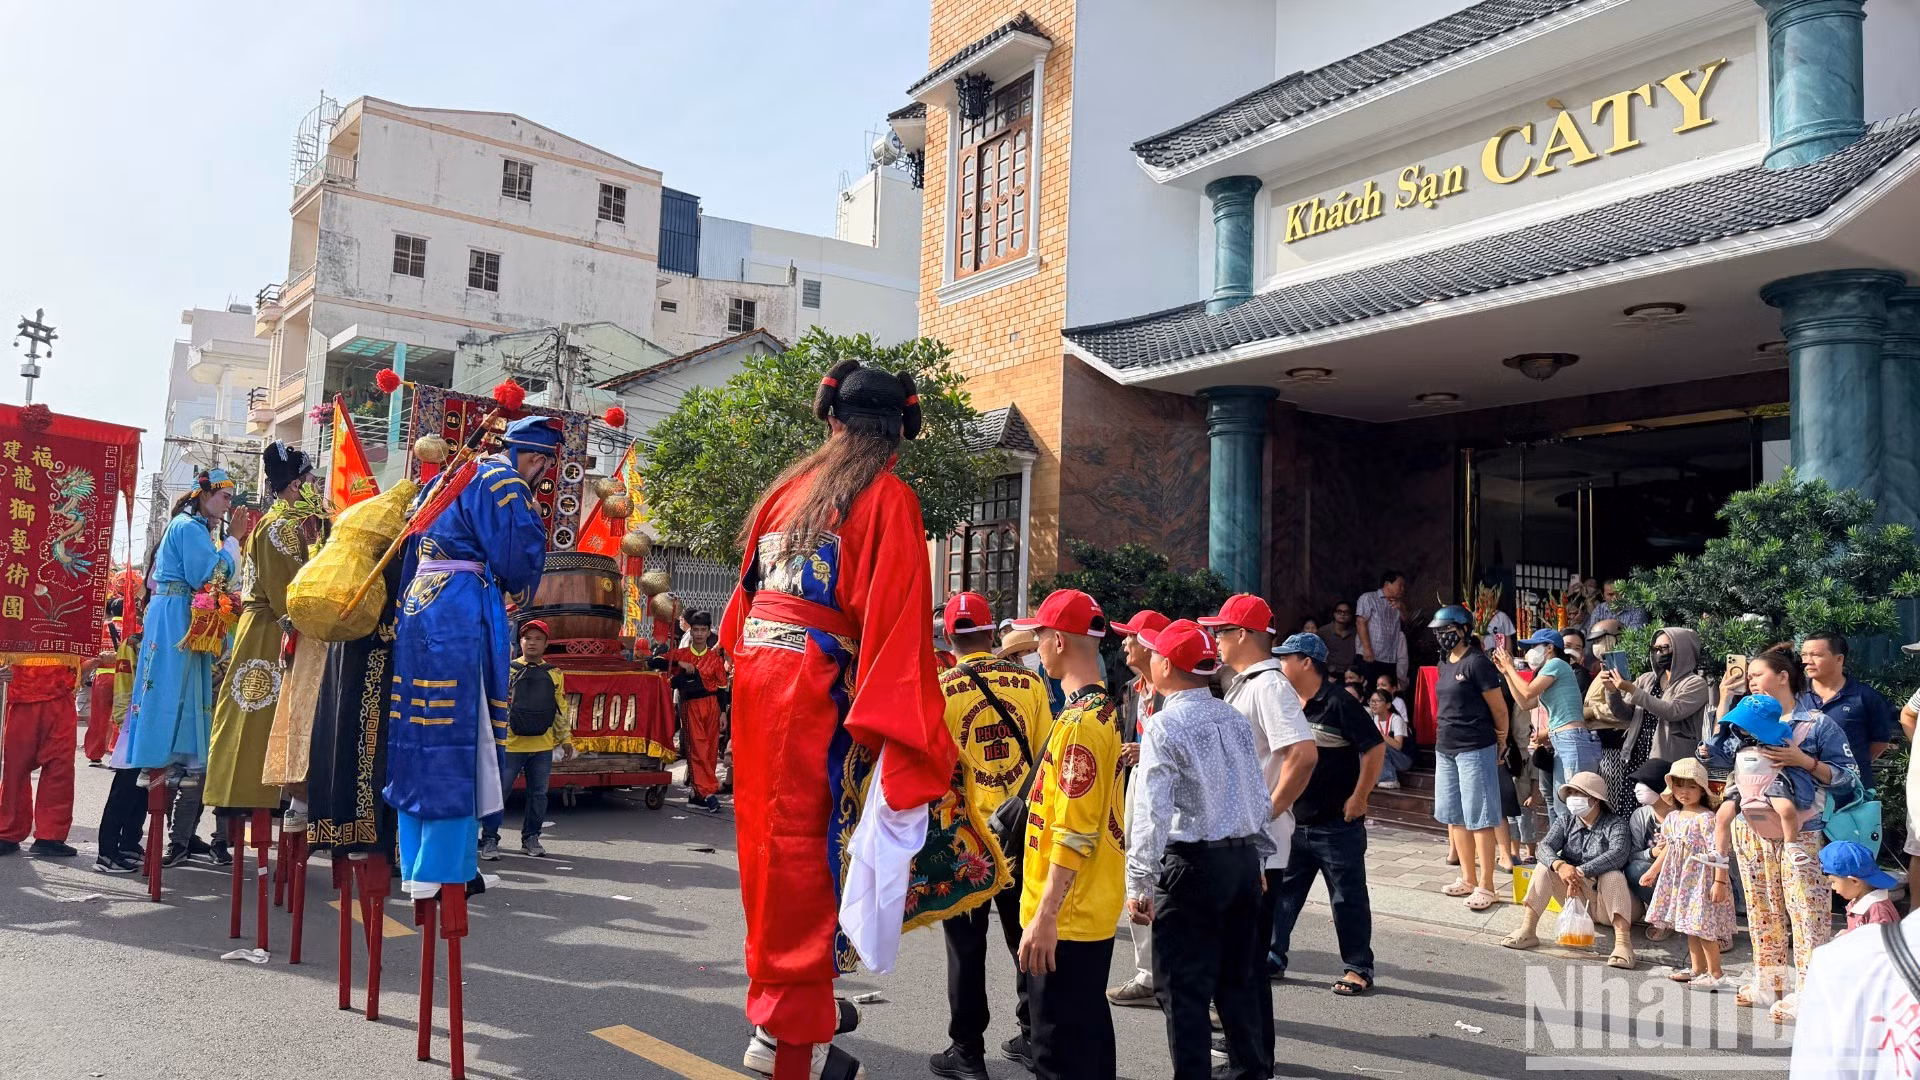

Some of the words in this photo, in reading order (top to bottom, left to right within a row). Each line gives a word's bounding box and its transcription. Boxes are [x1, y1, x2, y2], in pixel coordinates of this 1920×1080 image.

[1282, 180, 1381, 244] Khách
[1395, 161, 1465, 210] Sạn
[1481, 58, 1728, 184] CÀTY
